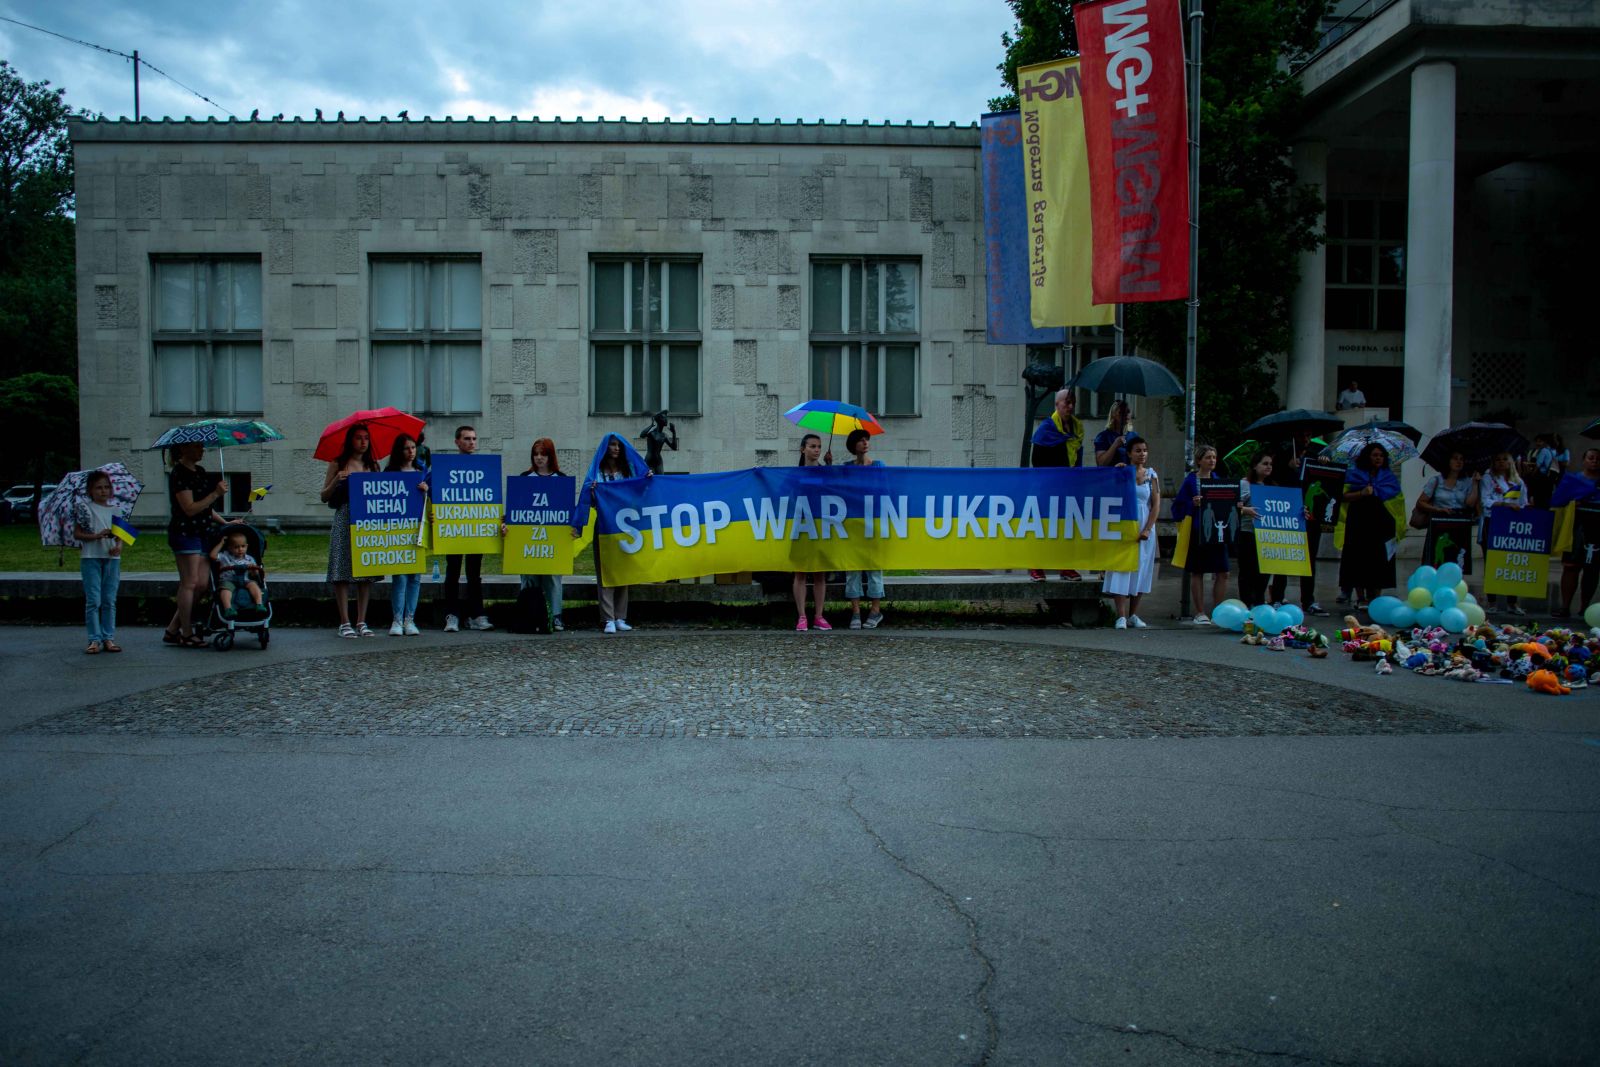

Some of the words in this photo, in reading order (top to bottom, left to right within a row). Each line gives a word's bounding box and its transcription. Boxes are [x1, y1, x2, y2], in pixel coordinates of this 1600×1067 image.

[449, 470, 484, 484] STOP
[362, 480, 409, 497] RUSIJA,
[441, 487, 494, 502] KILLING
[366, 499, 407, 515] NEHAJ
[532, 493, 549, 507] ZA
[1264, 499, 1291, 513] STOP
[436, 506, 500, 520] UKRANIAN
[510, 510, 569, 524] UKRAJINO!
[355, 517, 419, 532] POSILJEVATI
[615, 500, 731, 555] STOP
[742, 495, 848, 540] WAR
[863, 494, 908, 539] IN
[924, 494, 1124, 541] UKRAINE
[1260, 515, 1299, 529] KILLING
[1509, 521, 1533, 535] FOR
[438, 523, 499, 537] FAMILIES!
[531, 527, 548, 541] ZA
[1258, 531, 1305, 545] UKRANIAN
[1493, 536, 1546, 552] UKRAINE!
[361, 550, 416, 566] OTROKE!
[523, 545, 554, 558] MIR!
[1261, 547, 1305, 561] FAMILIES!
[1505, 553, 1529, 566] FOR
[1495, 567, 1537, 583] PEACE!
